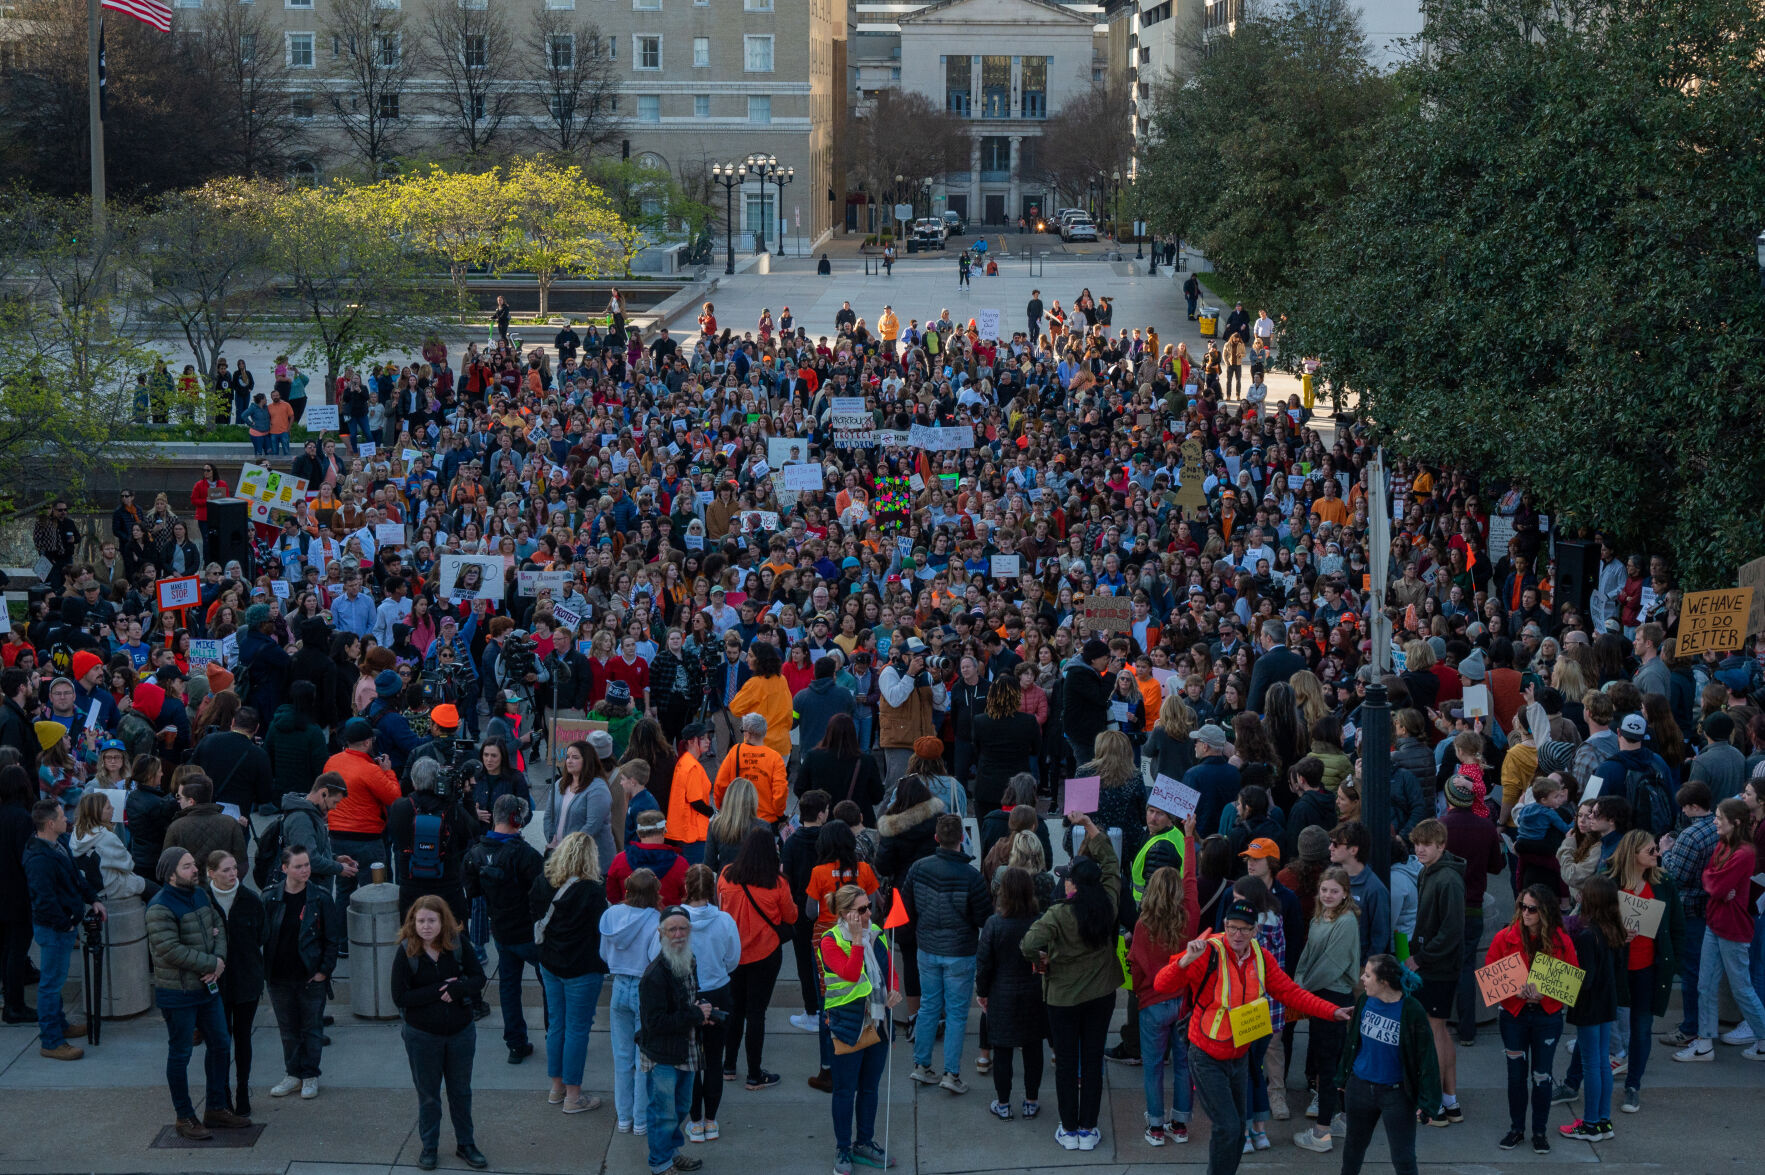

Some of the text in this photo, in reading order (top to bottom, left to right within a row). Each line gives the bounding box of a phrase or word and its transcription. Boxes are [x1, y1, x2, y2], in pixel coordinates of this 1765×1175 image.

[170, 583, 182, 591] MAKE
[1687, 595, 1744, 614] WE HAVE
[554, 605, 580, 625] PROTECT
[1086, 608, 1129, 620] KIDS
[1691, 615, 1732, 630] TO DO
[195, 641, 215, 649] MIKE
[1681, 629, 1738, 652] BETTER
[190, 649, 217, 657] HALLIE
[1624, 894, 1650, 911] KIDS
[1477, 953, 1521, 983] PROTECT
[1534, 953, 1585, 982] GUN CONTROL
[1547, 967, 1563, 979] NOT
[1493, 973, 1509, 986] OUR
[1529, 969, 1564, 988] THOUGHTS
[1540, 982, 1575, 1004] PRAYERS
[1252, 1021, 1266, 1031] DEATH
[1365, 1012, 1401, 1034] PRO LIFE
[1361, 1023, 1398, 1044] MY ASS
